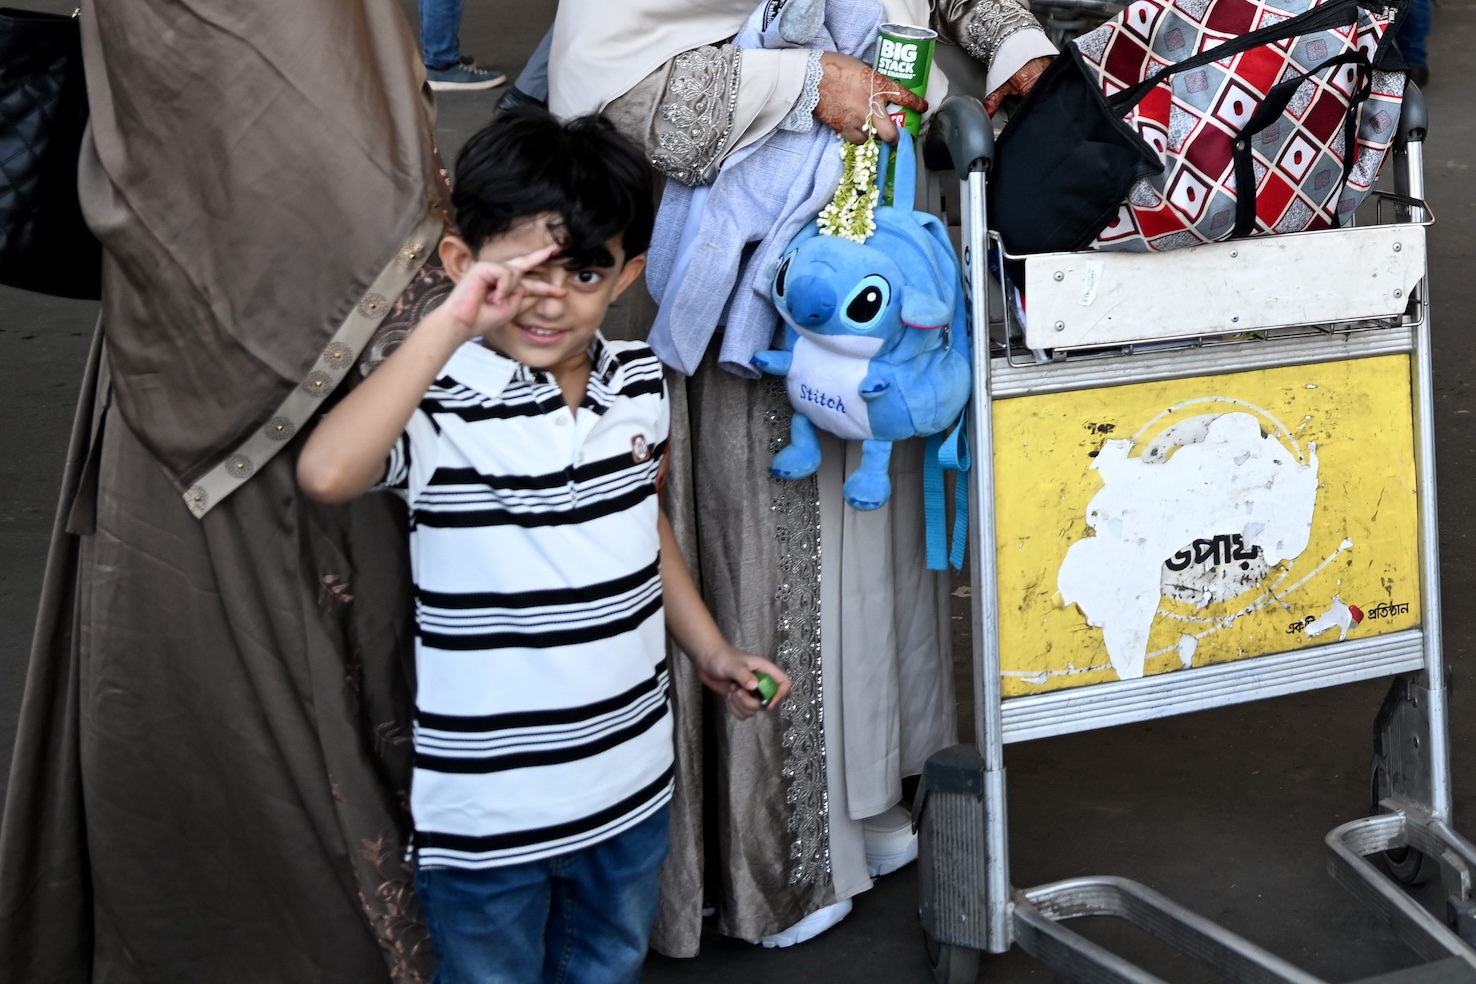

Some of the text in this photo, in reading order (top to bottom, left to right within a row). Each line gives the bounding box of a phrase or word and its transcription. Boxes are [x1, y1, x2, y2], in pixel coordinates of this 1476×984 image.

[881, 38, 918, 63] BIG
[879, 57, 915, 73] STACK
[800, 383, 846, 414] Stitch
